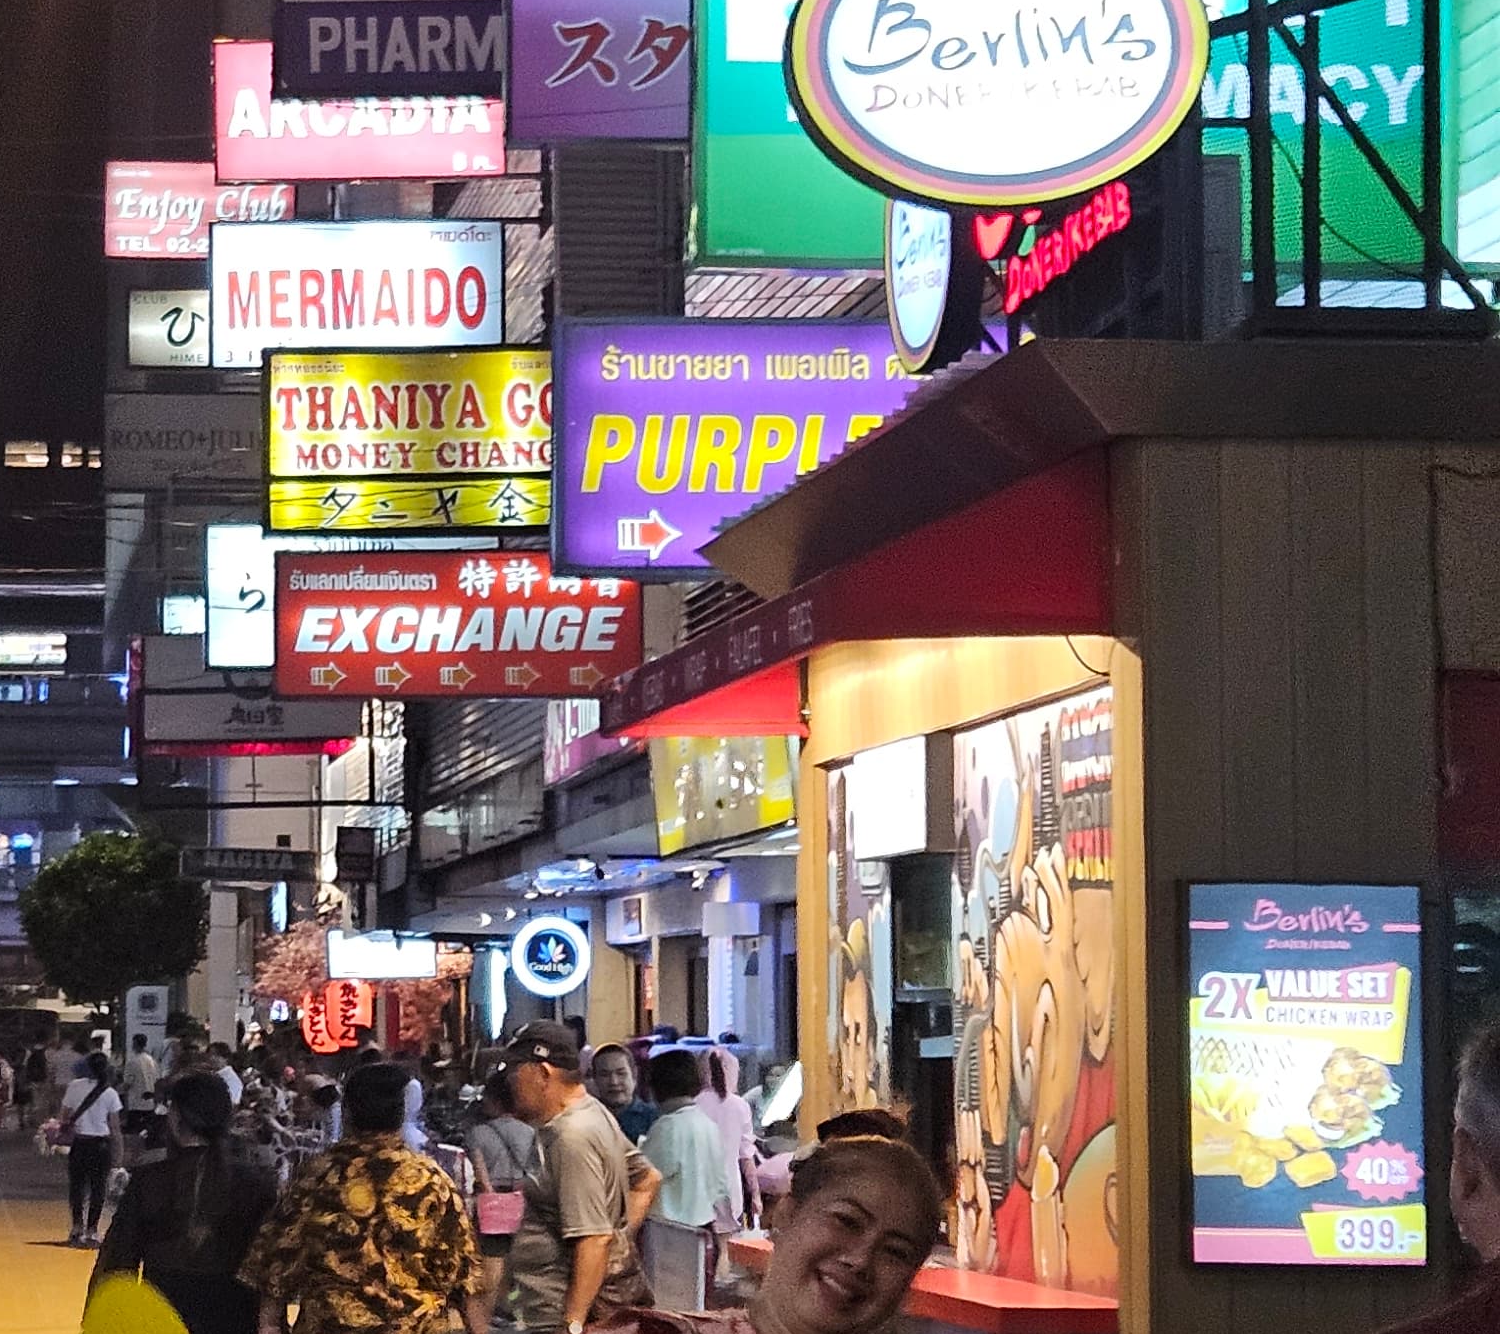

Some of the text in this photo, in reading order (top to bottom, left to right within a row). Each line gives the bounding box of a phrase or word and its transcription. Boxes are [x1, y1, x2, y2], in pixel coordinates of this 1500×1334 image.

[115, 184, 288, 235] Enjoy Club
[227, 265, 487, 331] MERMAIDO
[169, 353, 205, 364] HIME
[601, 344, 749, 381] ร้านขายยา
[276, 382, 486, 431] THANIYA
[296, 442, 418, 470] MONEY
[293, 606, 625, 654] EXCHANGE
[1243, 898, 1371, 934] Berlin's
[1204, 969, 1391, 1021] 2X VALUE SET
[1264, 1007, 1396, 1028] CHICKEN WRAP
